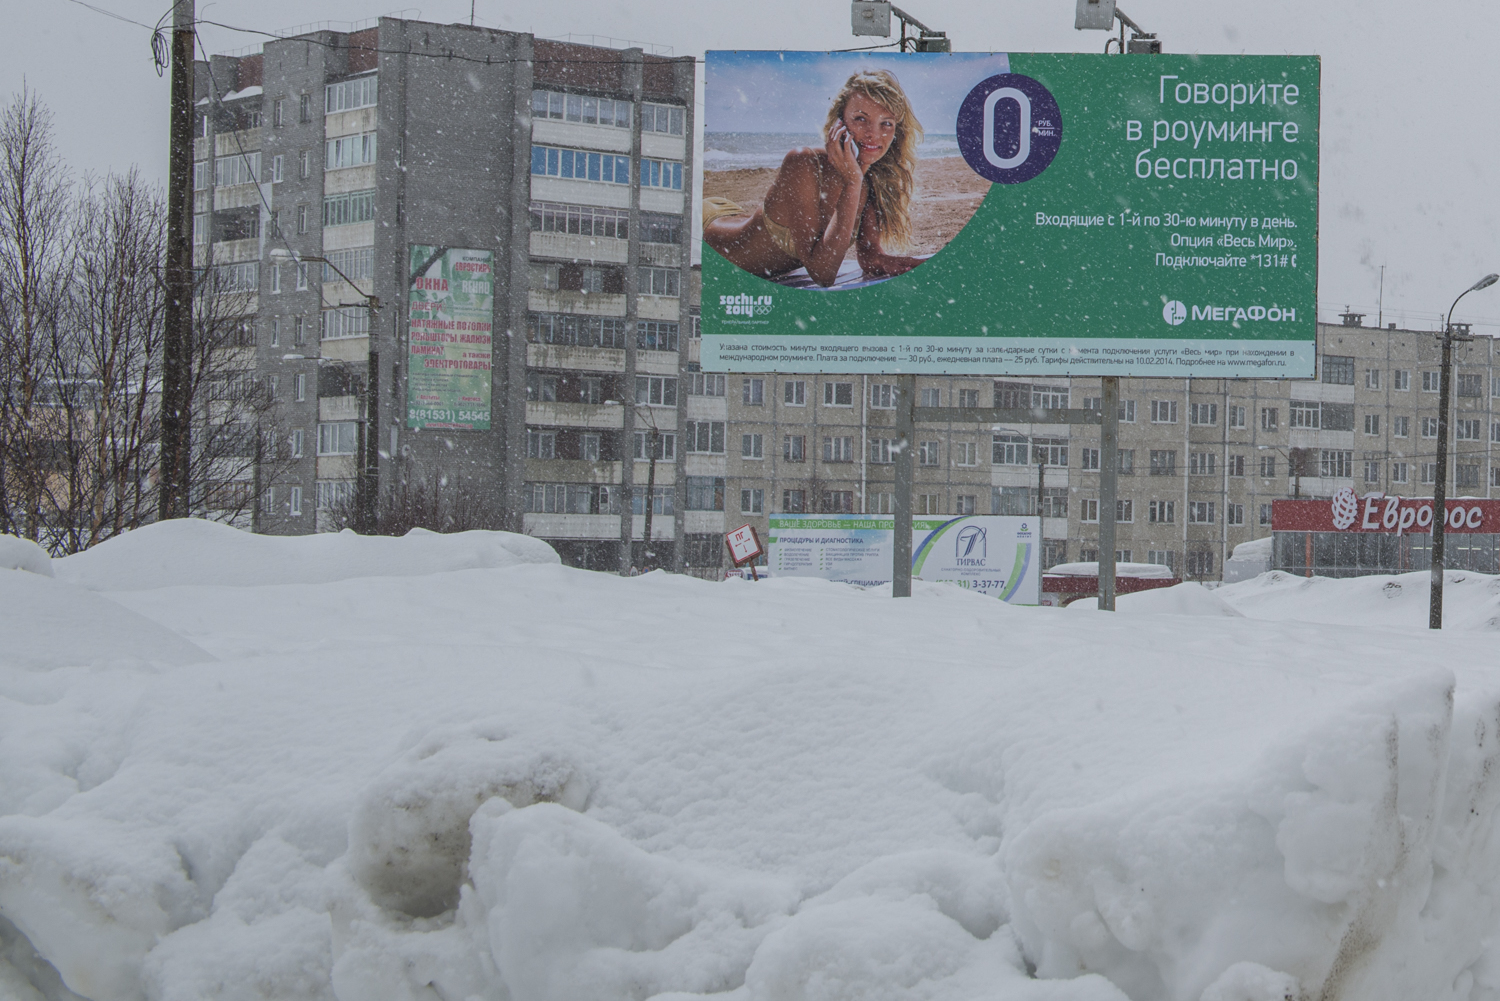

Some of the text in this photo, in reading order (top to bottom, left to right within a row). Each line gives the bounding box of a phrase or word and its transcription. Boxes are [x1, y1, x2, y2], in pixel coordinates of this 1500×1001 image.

[1160, 75, 1299, 112] Говорите
[983, 87, 1031, 169] 0
[1126, 120, 1298, 149] в роуминге
[1135, 149, 1298, 180] бесплатно
[1035, 212, 1298, 230] Входящие с 1-й по 30-ю минуту в день.
[1170, 233, 1297, 251] Опция «Весь Мир».
[1155, 253, 1247, 270] Подключайте
[415, 277, 449, 291] ОКНА
[719, 293, 772, 305] sochi.ru
[411, 319, 492, 331] НАТЯЖНЫЕ ПОТОЛКИ
[459, 334, 492, 344] ЖАЛЮЗИ
[411, 345, 445, 355] ЛАМИНАТ
[719, 343, 748, 352] Указана
[751, 344, 787, 352] стоимость
[790, 344, 817, 352] минуты
[820, 345, 859, 353] входящего
[862, 345, 888, 353] вызова
[914, 346, 923, 354] по
[926, 345, 944, 353] 30-ю
[947, 346, 972, 354] минуту
[987, 346, 1035, 354] календарные
[1038, 347, 1058, 355] сутки
[1102, 348, 1150, 356] подключения
[1154, 348, 1178, 356] услуги
[1181, 348, 1201, 356] «Весь
[1205, 348, 1222, 356] мир»
[1226, 349, 1239, 357] при
[1242, 349, 1287, 357] нахождении
[424, 358, 491, 371] ЭЛЕКТРОТОВАРЫ
[719, 353, 778, 362] международном
[780, 354, 815, 362] роуминге.
[816, 354, 838, 362] Плата
[849, 355, 897, 363] подключение
[908, 355, 918, 363] 30
[936, 356, 981, 364] ежедневная
[1014, 356, 1023, 364] 25
[1024, 356, 1040, 365] руб.
[1041, 357, 1069, 365] Тарифы
[1070, 357, 1124, 366] действительны
[1136, 357, 1174, 365] 10.02.2014.
[1176, 358, 1216, 367] Подробнее
[409, 409, 490, 421] 8(81531) 54545
[779, 520, 801, 528] ВАШЕ
[802, 520, 842, 529] ЗДОРОВЬЕ
[853, 521, 876, 529] НАША
[735, 531, 744, 541] ПГ
[820, 537, 864, 545] ДИАГНОСТИКА
[956, 558, 987, 566] ТИРВАС
